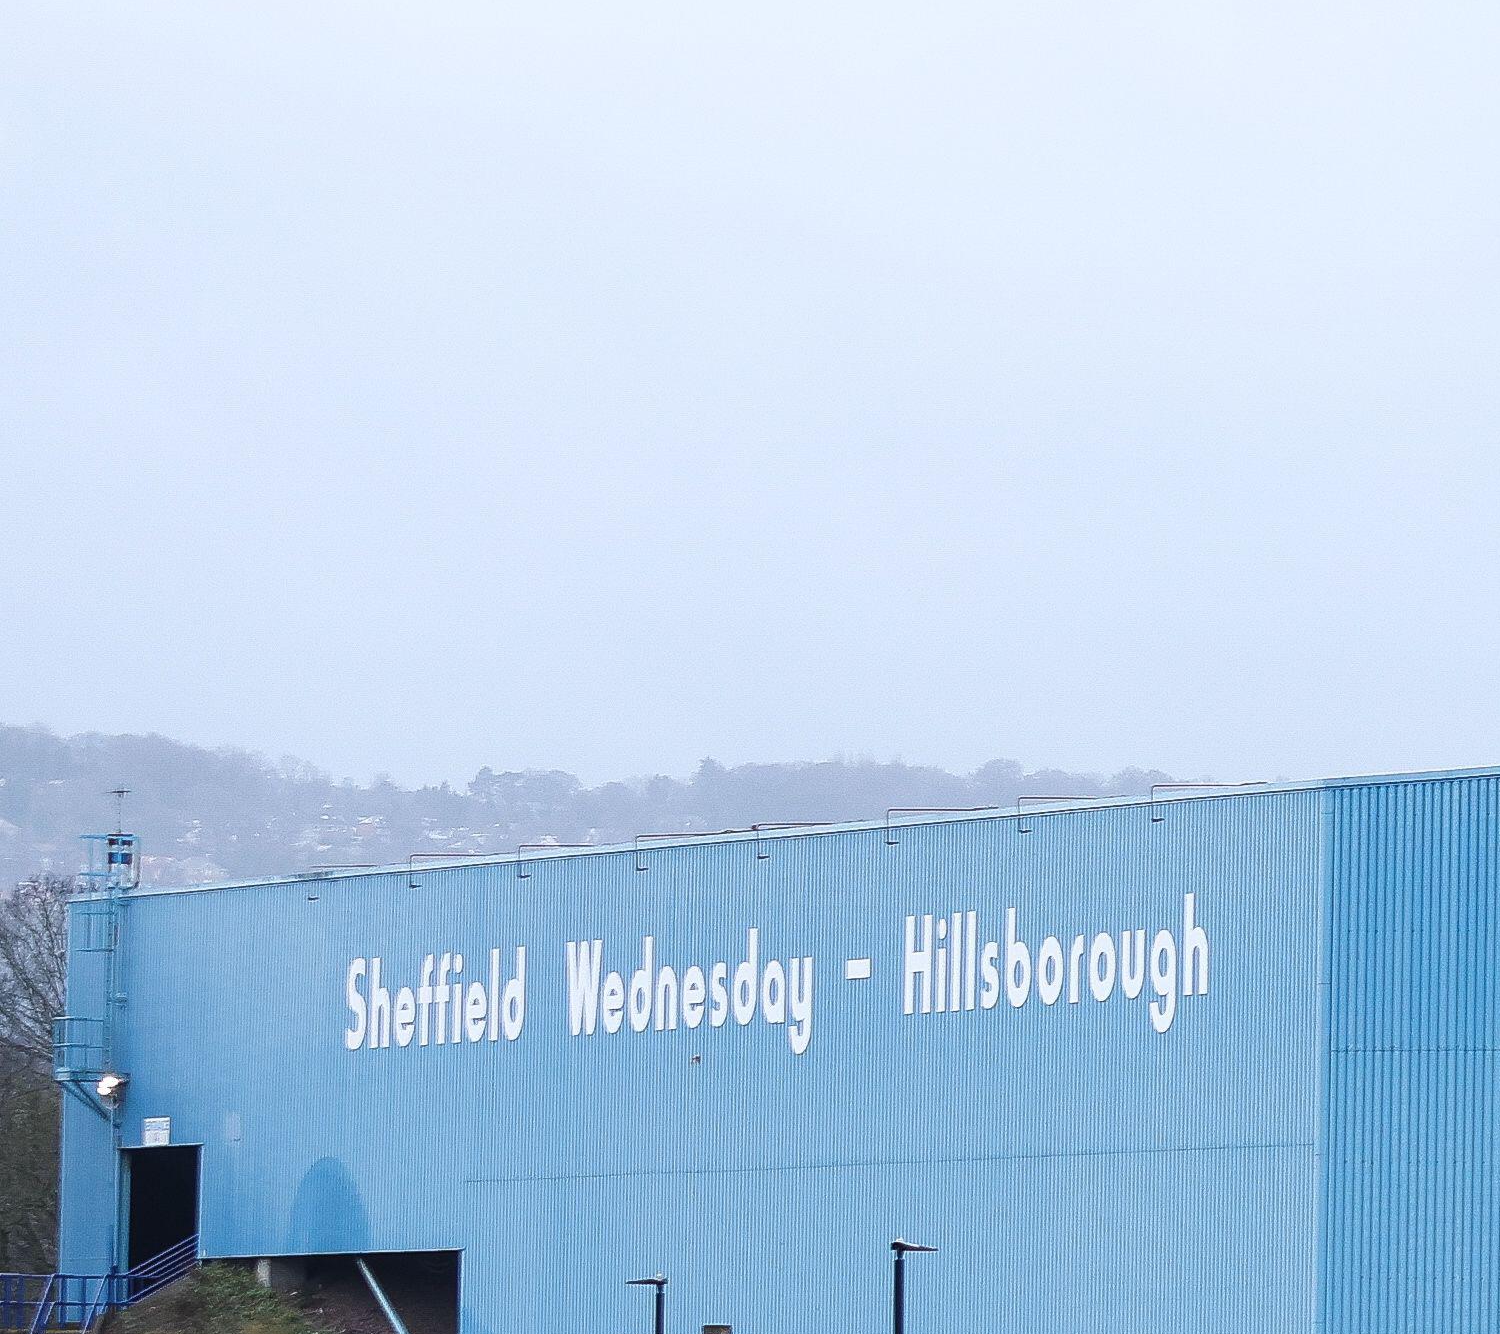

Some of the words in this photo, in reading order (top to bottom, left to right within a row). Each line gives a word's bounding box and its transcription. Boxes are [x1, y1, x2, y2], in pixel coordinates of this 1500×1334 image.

[345, 945, 527, 1051] Sheffield
[565, 927, 814, 1055] Wednesday
[903, 892, 1209, 1034] Hillsborough
